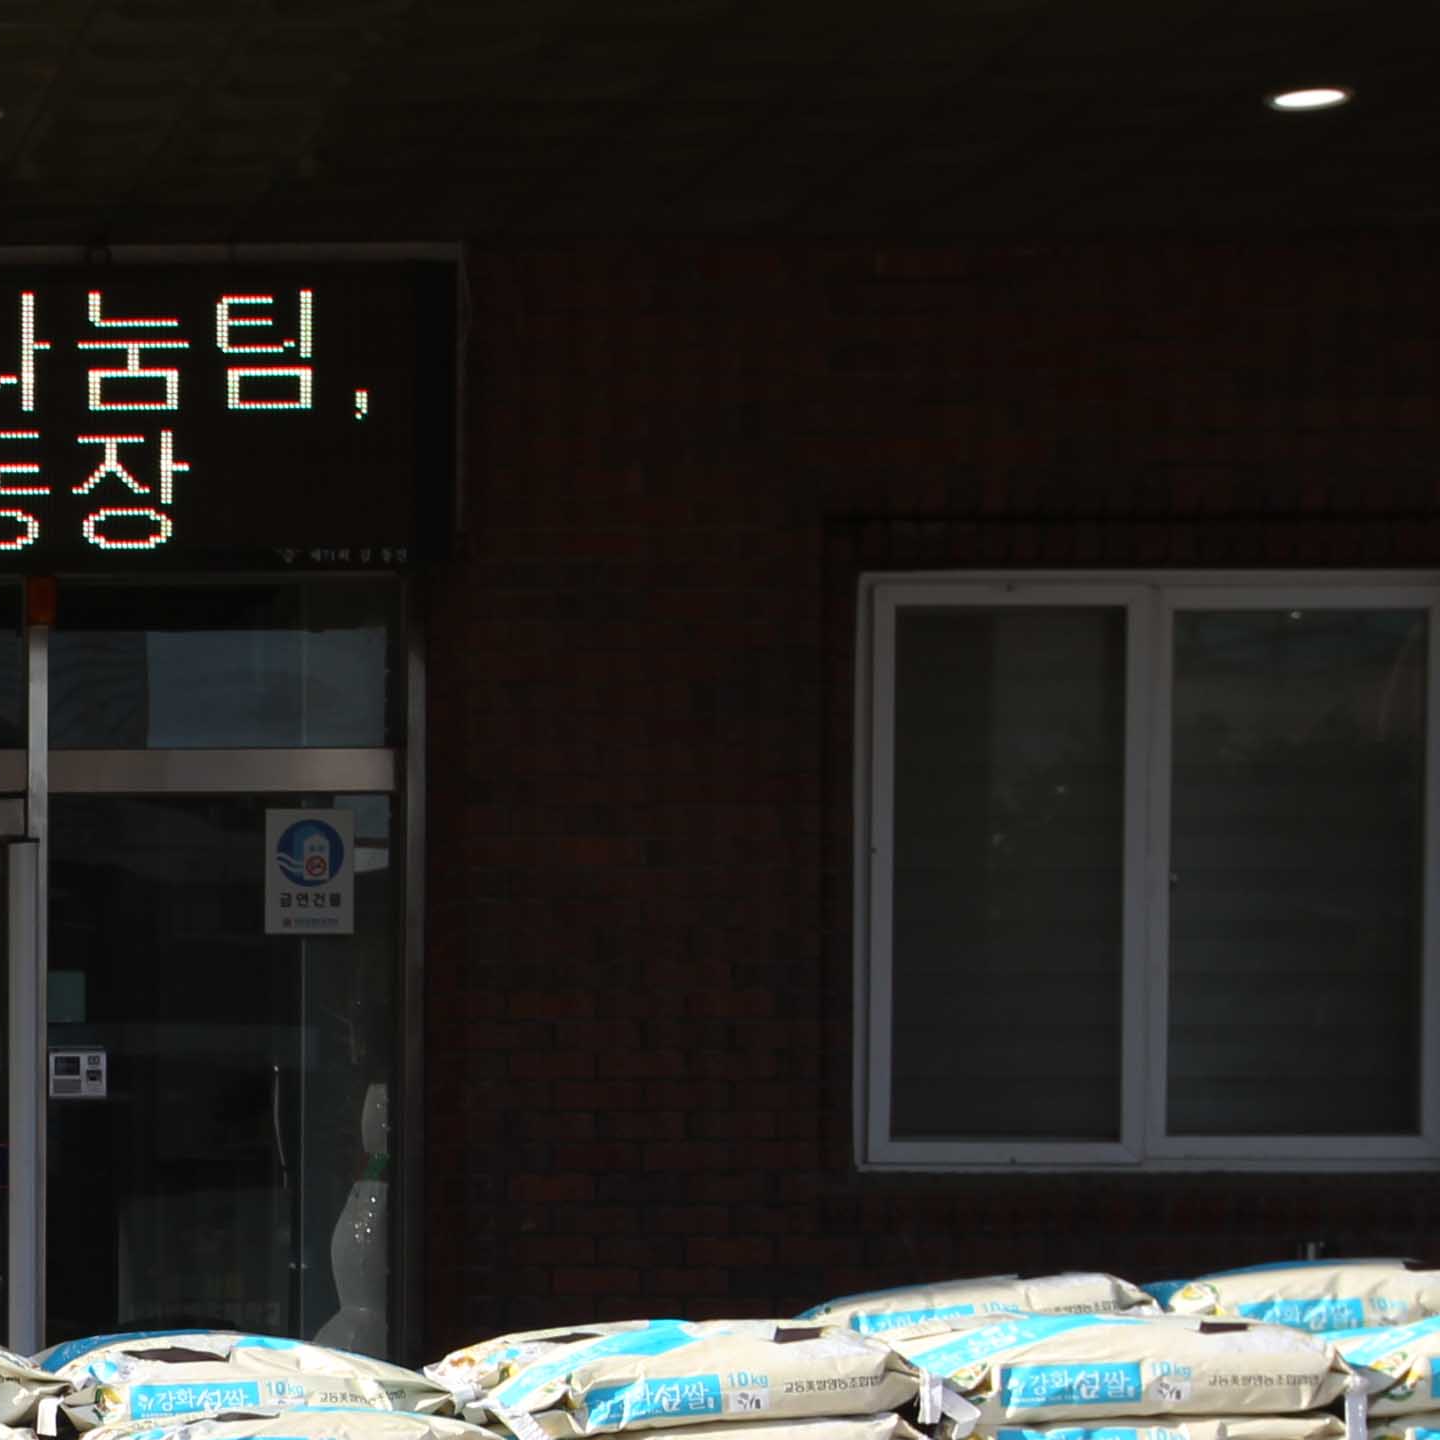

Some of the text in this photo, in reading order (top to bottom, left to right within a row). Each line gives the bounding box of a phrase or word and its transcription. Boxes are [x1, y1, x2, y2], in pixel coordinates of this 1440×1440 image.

[1151, 1361, 1192, 1379] 10kg
[727, 1371, 768, 1388] 10kg
[266, 1380, 304, 1397] 10kg
